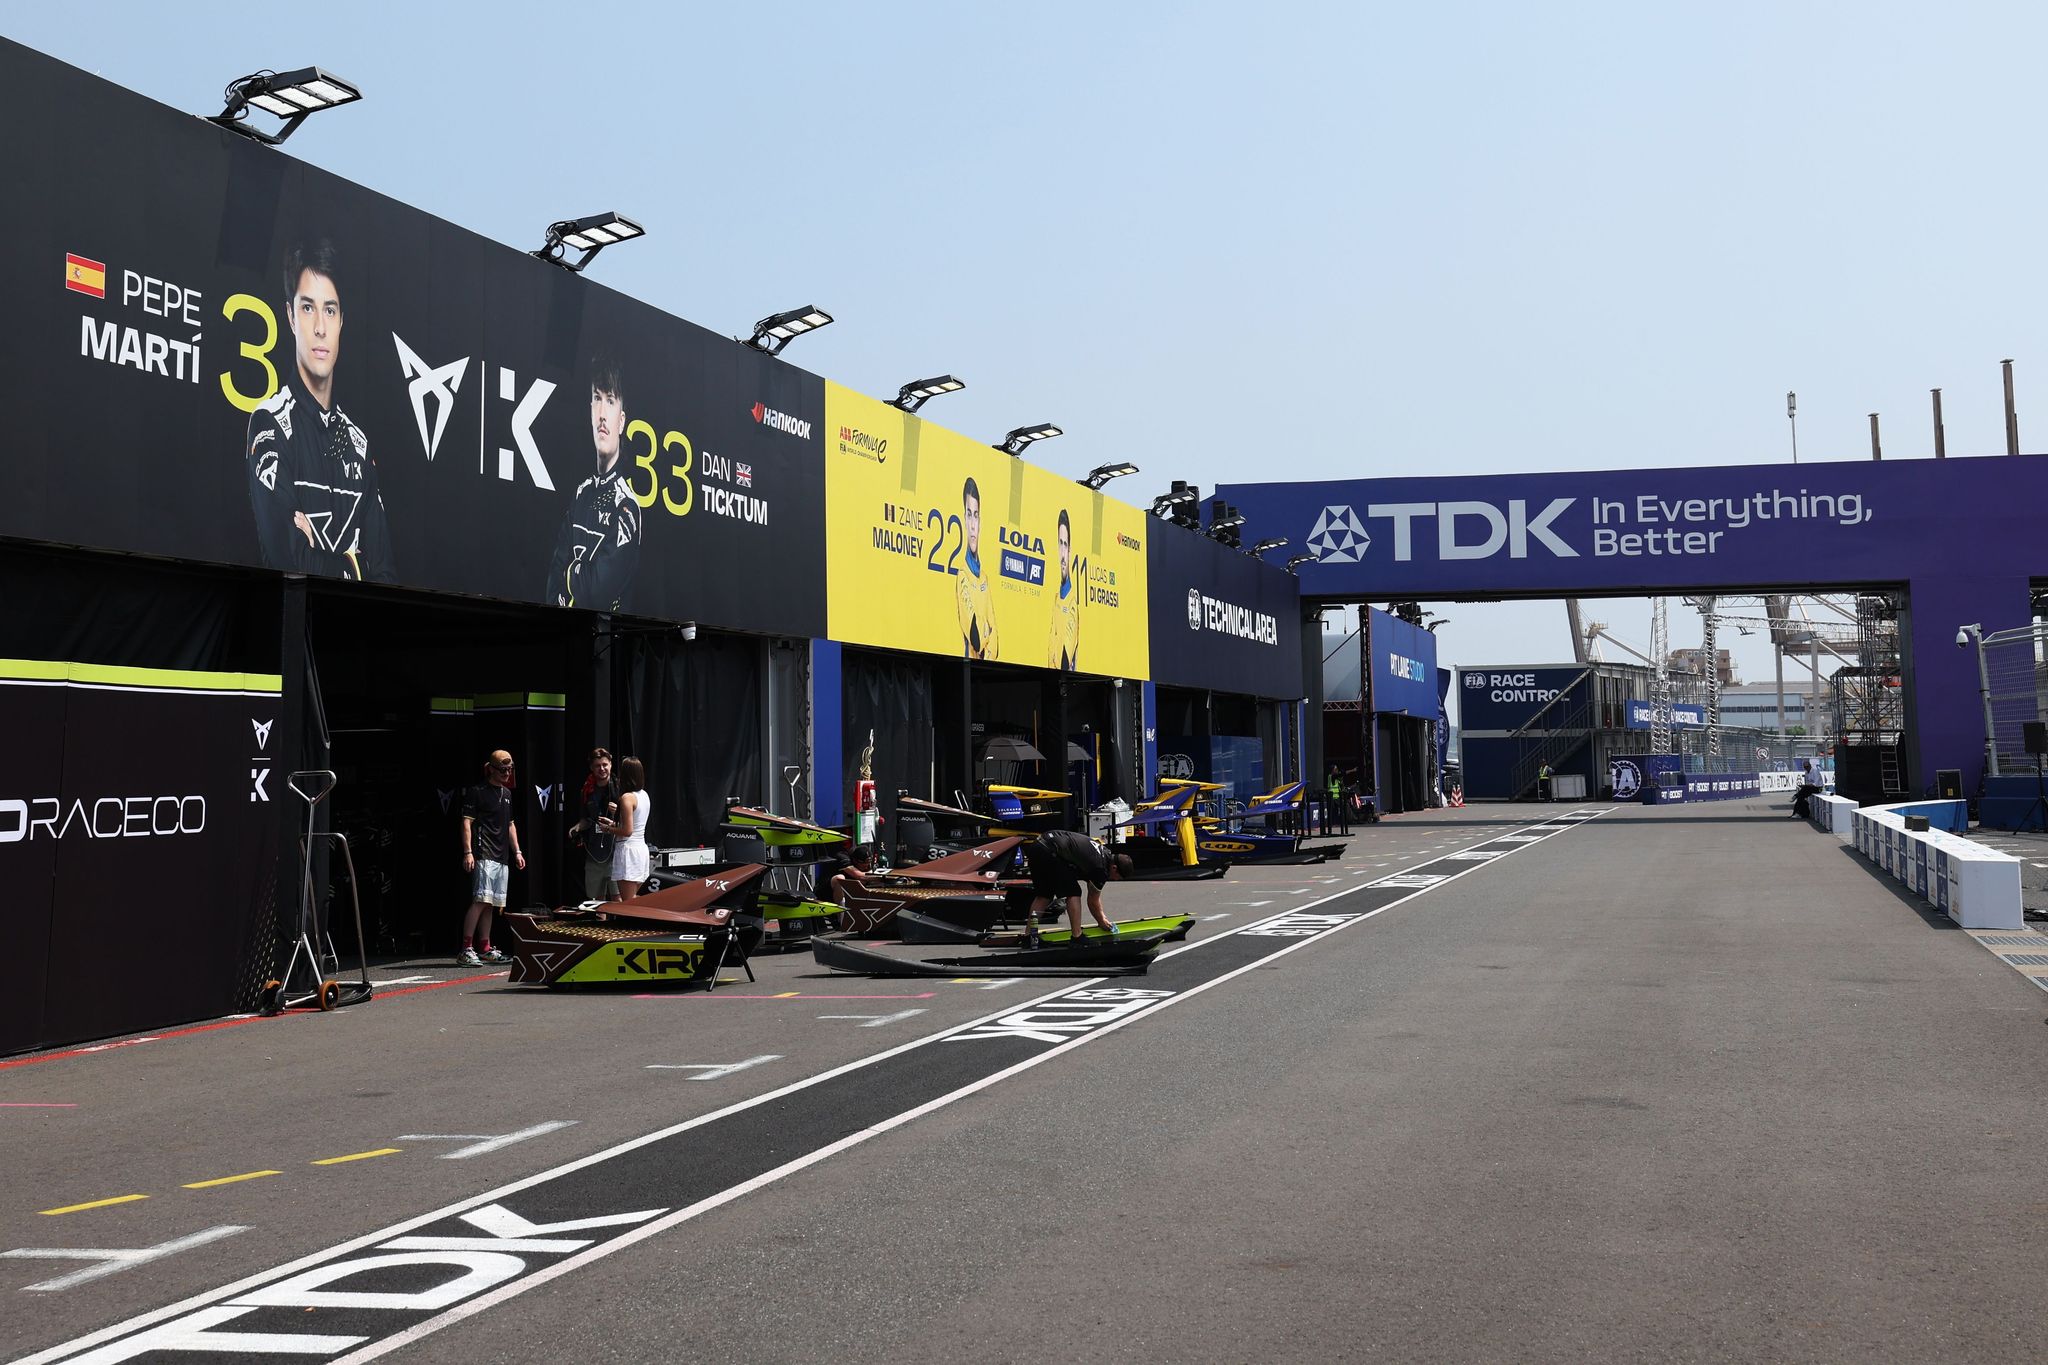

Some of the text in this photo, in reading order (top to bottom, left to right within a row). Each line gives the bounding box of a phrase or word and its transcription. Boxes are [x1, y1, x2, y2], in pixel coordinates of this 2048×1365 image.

[123, 269, 202, 327] PEPE
[81, 315, 202, 383] MARTÍ
[220, 293, 279, 413] 3
[626, 419, 693, 517] 33
[702, 451, 731, 482] DAN
[702, 484, 768, 526] TICKTUM
[899, 506, 923, 531] ZANE
[1368, 489, 1873, 561] TDK In Everything,
[873, 526, 923, 559] MALONEY
[928, 508, 963, 575] 22
[999, 526, 1045, 555] LOLA
[1593, 527, 1724, 558] Better
[1072, 554, 1088, 607] 11
[1090, 565, 1107, 583] LUCAS
[1090, 586, 1119, 608] DI GRASSI
[1202, 596, 1254, 640] TECHNICAL
[1255, 612, 1278, 646] AREA
[1490, 674, 1535, 687] RACE
[30, 796, 206, 840] RACECO
[928, 848, 947, 860] 33
[50, 1202, 671, 1365] TDK
